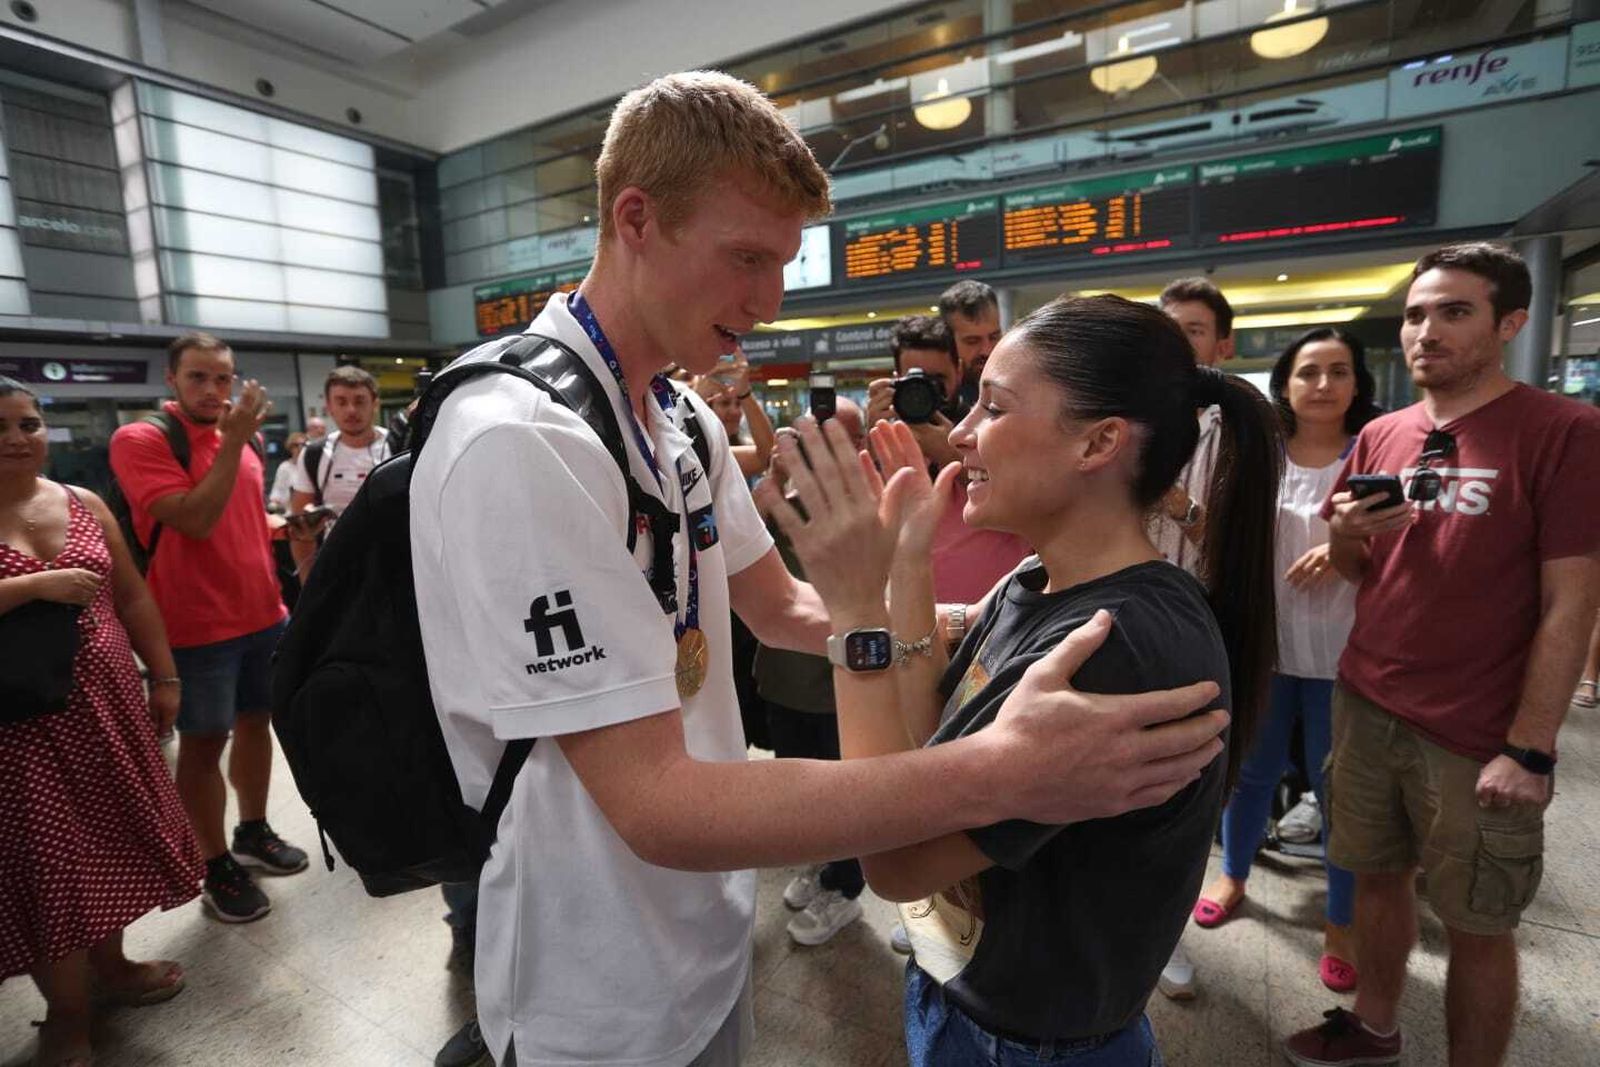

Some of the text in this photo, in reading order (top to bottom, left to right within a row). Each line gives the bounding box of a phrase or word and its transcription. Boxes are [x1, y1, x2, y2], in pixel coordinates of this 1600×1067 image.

[1413, 53, 1508, 87] renfe
[524, 590, 586, 657] fi
[525, 645, 607, 675] network
